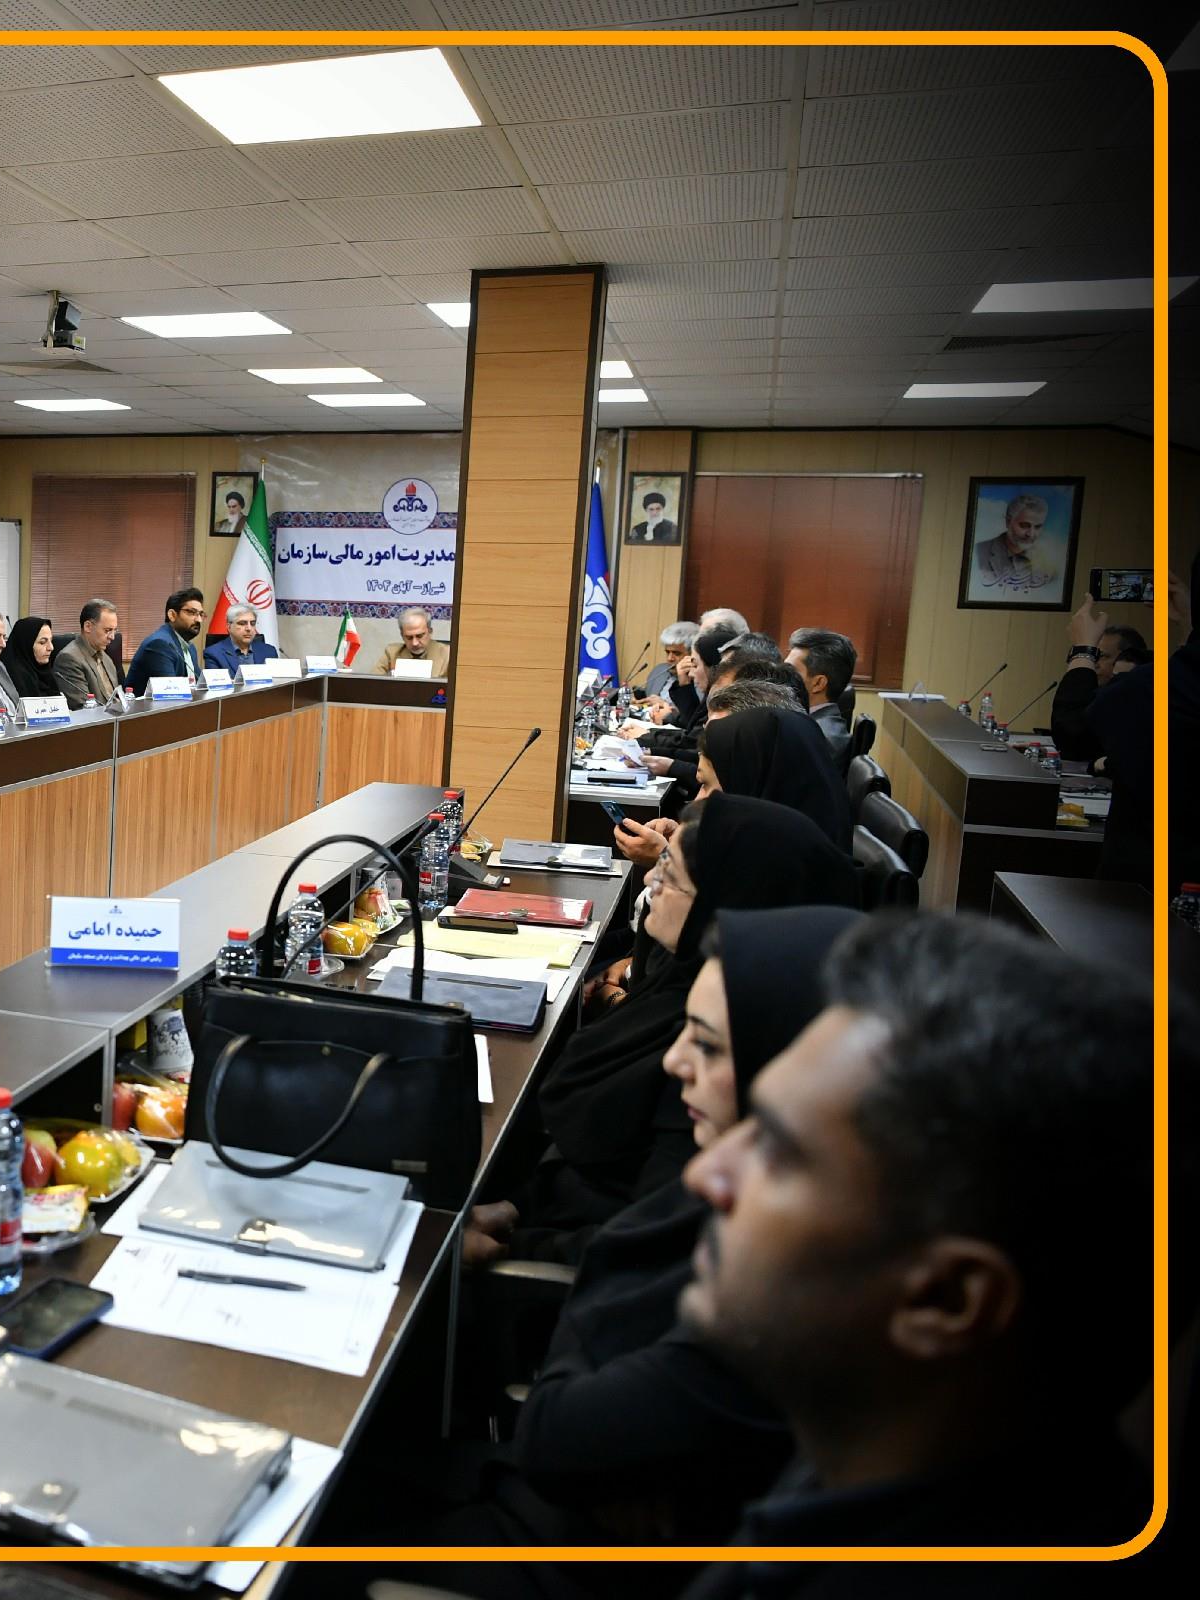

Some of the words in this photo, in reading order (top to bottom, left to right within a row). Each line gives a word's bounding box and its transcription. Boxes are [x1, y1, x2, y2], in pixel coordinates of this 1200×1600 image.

[277, 543, 328, 565] سازمان
[329, 543, 364, 566] مالی
[364, 543, 397, 567] امور
[397, 546, 456, 567] مدیریت
[366, 579, 391, 593] ۱۴۰۴
[391, 579, 413, 595] آبان
[421, 580, 446, 596] شیراز
[68, 921, 111, 940] امامی
[115, 925, 162, 942] حمیده
